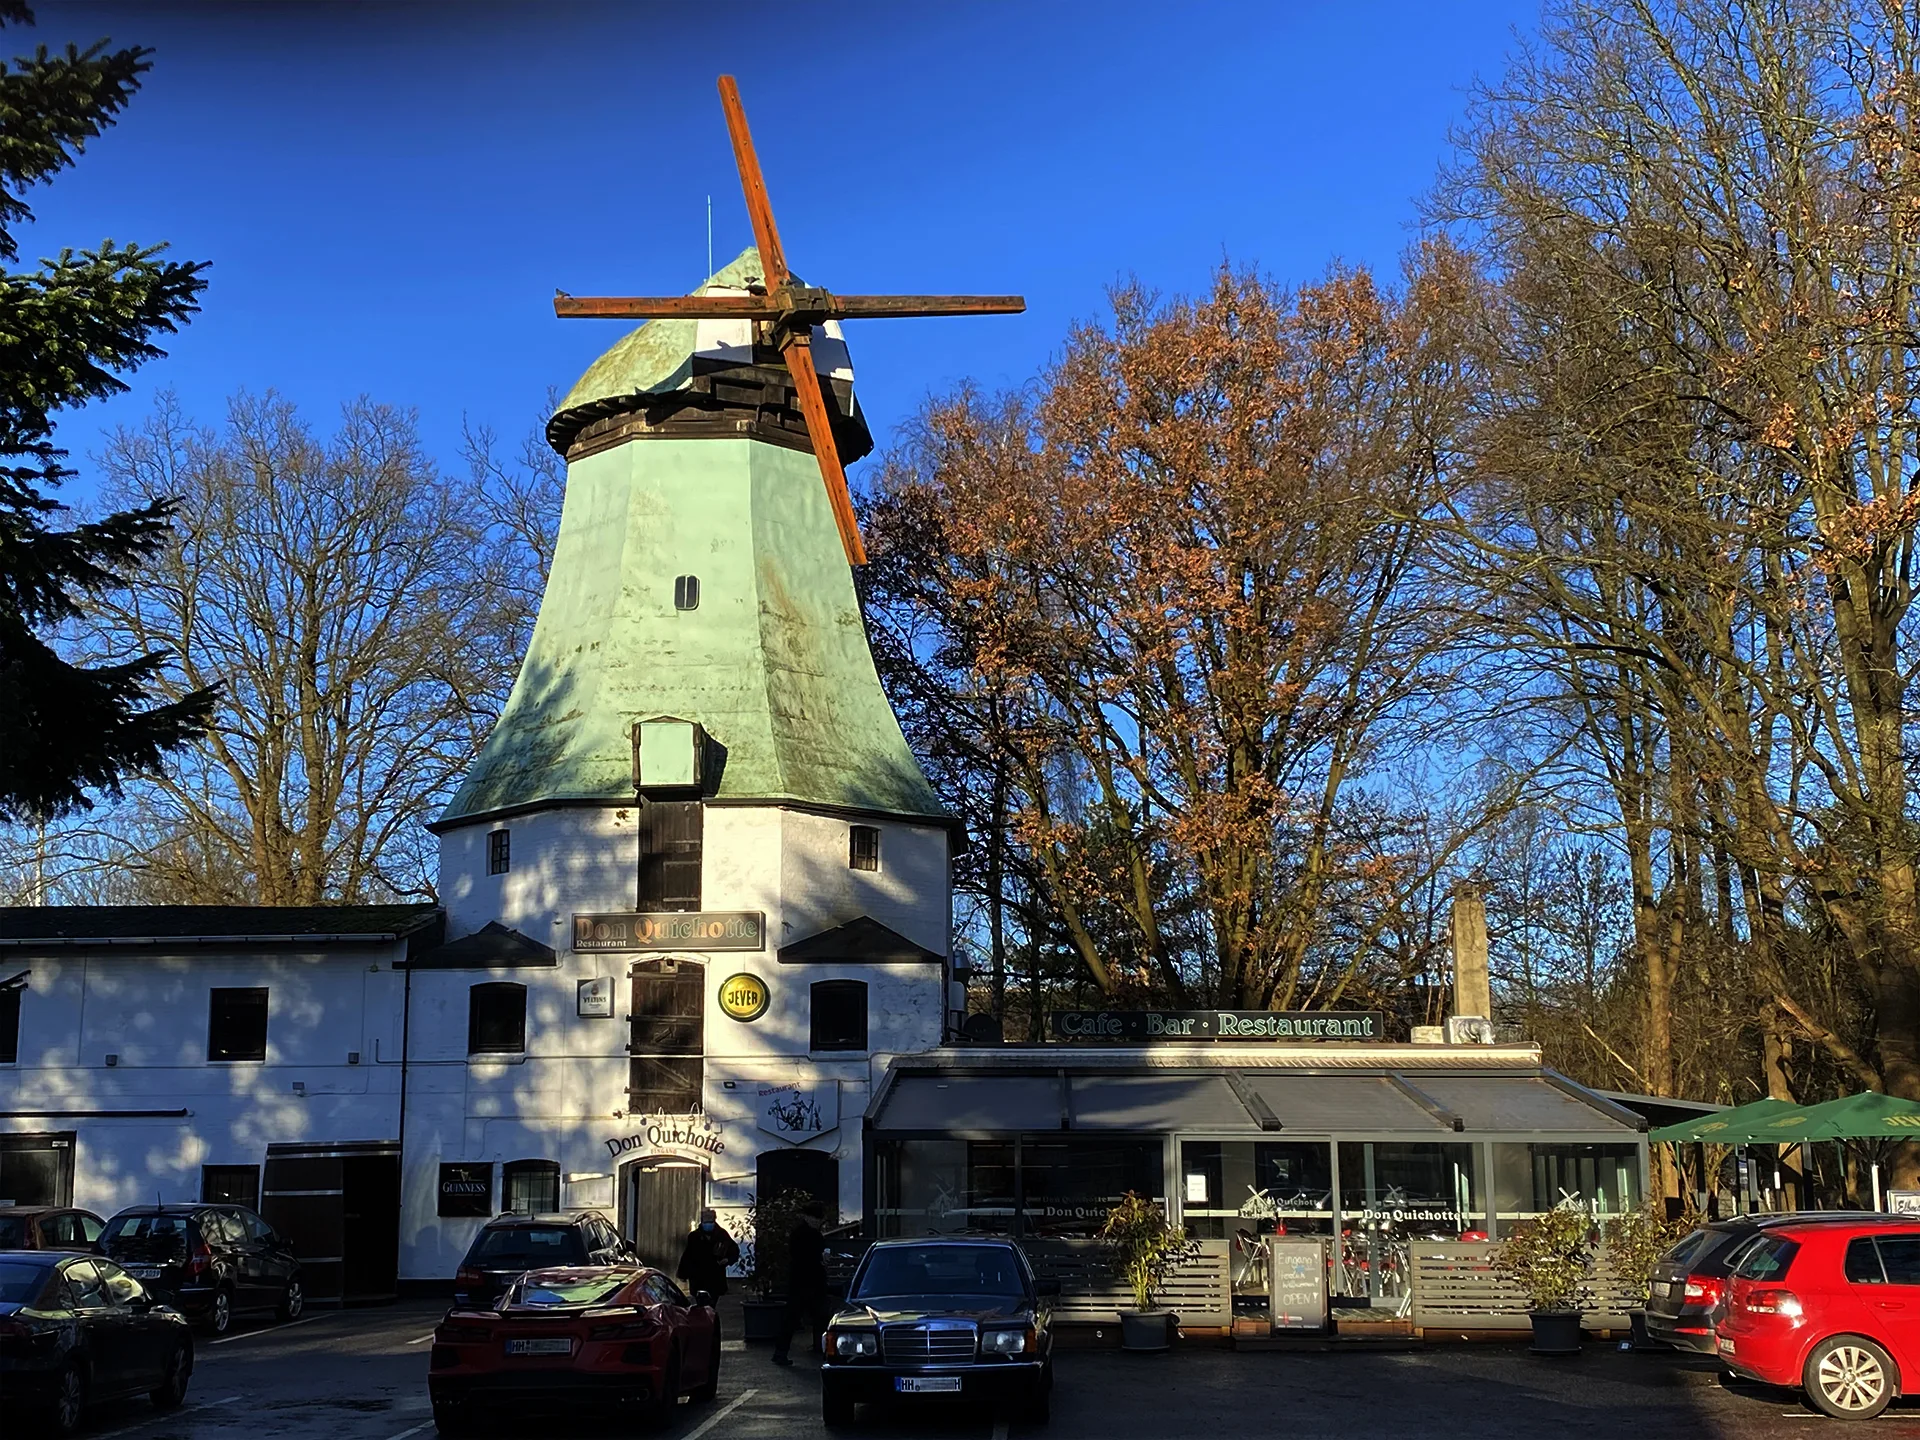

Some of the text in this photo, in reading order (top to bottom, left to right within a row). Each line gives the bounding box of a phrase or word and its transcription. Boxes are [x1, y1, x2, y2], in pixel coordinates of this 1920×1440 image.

[576, 917, 758, 944] Don Quichotte
[576, 939, 627, 948] Restaurant
[728, 990, 758, 1007] JEVER
[1061, 1012, 1373, 1036] Cafe Bar Restaurant
[758, 1082, 801, 1097] Restaurant
[604, 1125, 725, 1158] Don Quichotte
[442, 1181, 486, 1193] GUINNESS
[1046, 1206, 1072, 1217] Don
[1363, 1209, 1391, 1220] Don
[901, 1379, 914, 1390] HH
